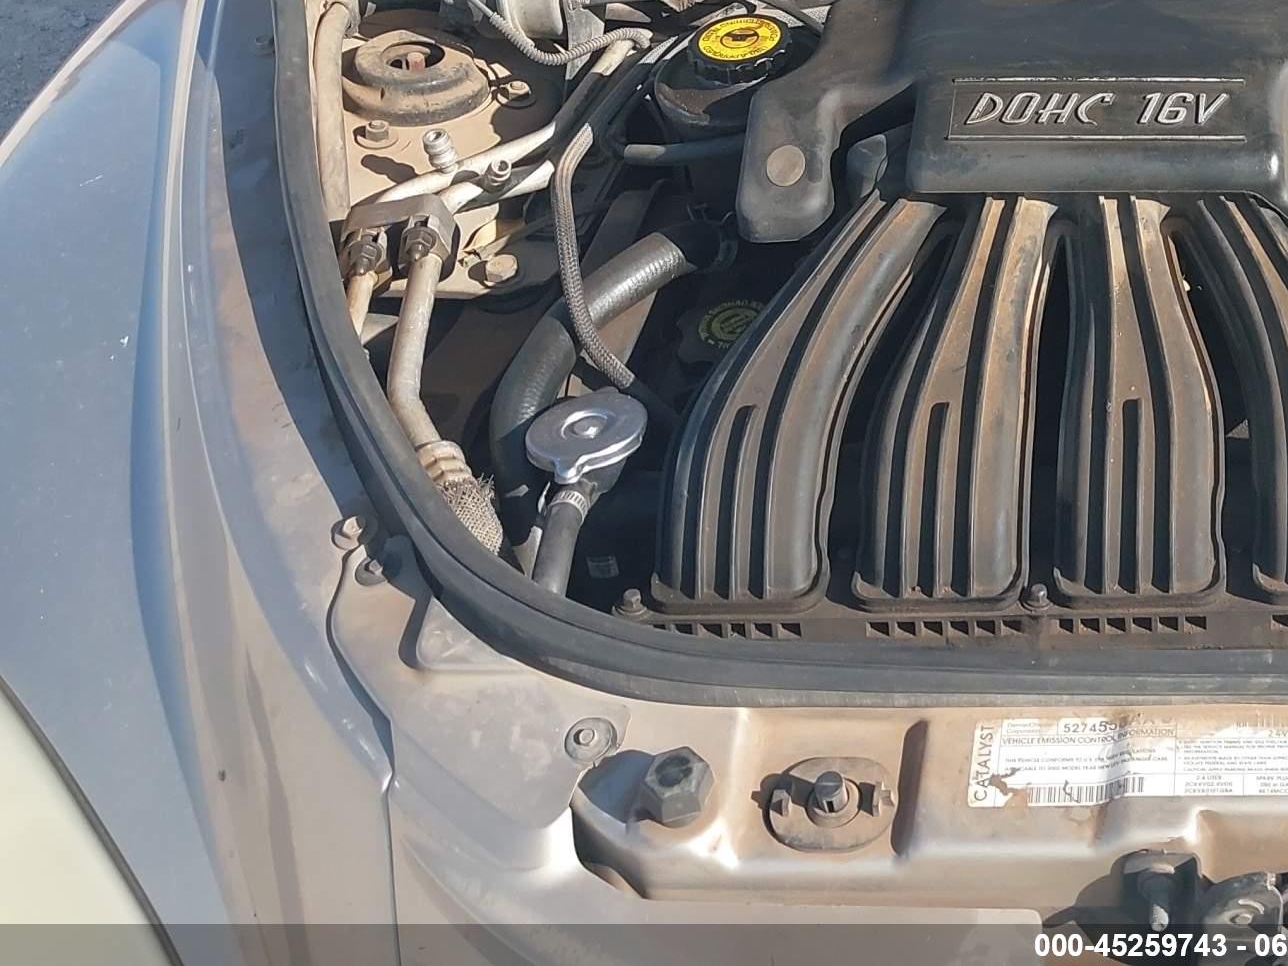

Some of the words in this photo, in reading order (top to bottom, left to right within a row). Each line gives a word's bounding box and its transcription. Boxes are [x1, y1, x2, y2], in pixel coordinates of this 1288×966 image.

[964, 91, 1115, 126] DOHC
[1136, 91, 1231, 126] 16V
[1002, 736, 1035, 745] VEHICLE
[1037, 735, 1075, 745] EMISSION
[1077, 734, 1116, 744] CONTROL
[1117, 728, 1174, 740] INFORMATION
[973, 724, 995, 802] CATALYST
